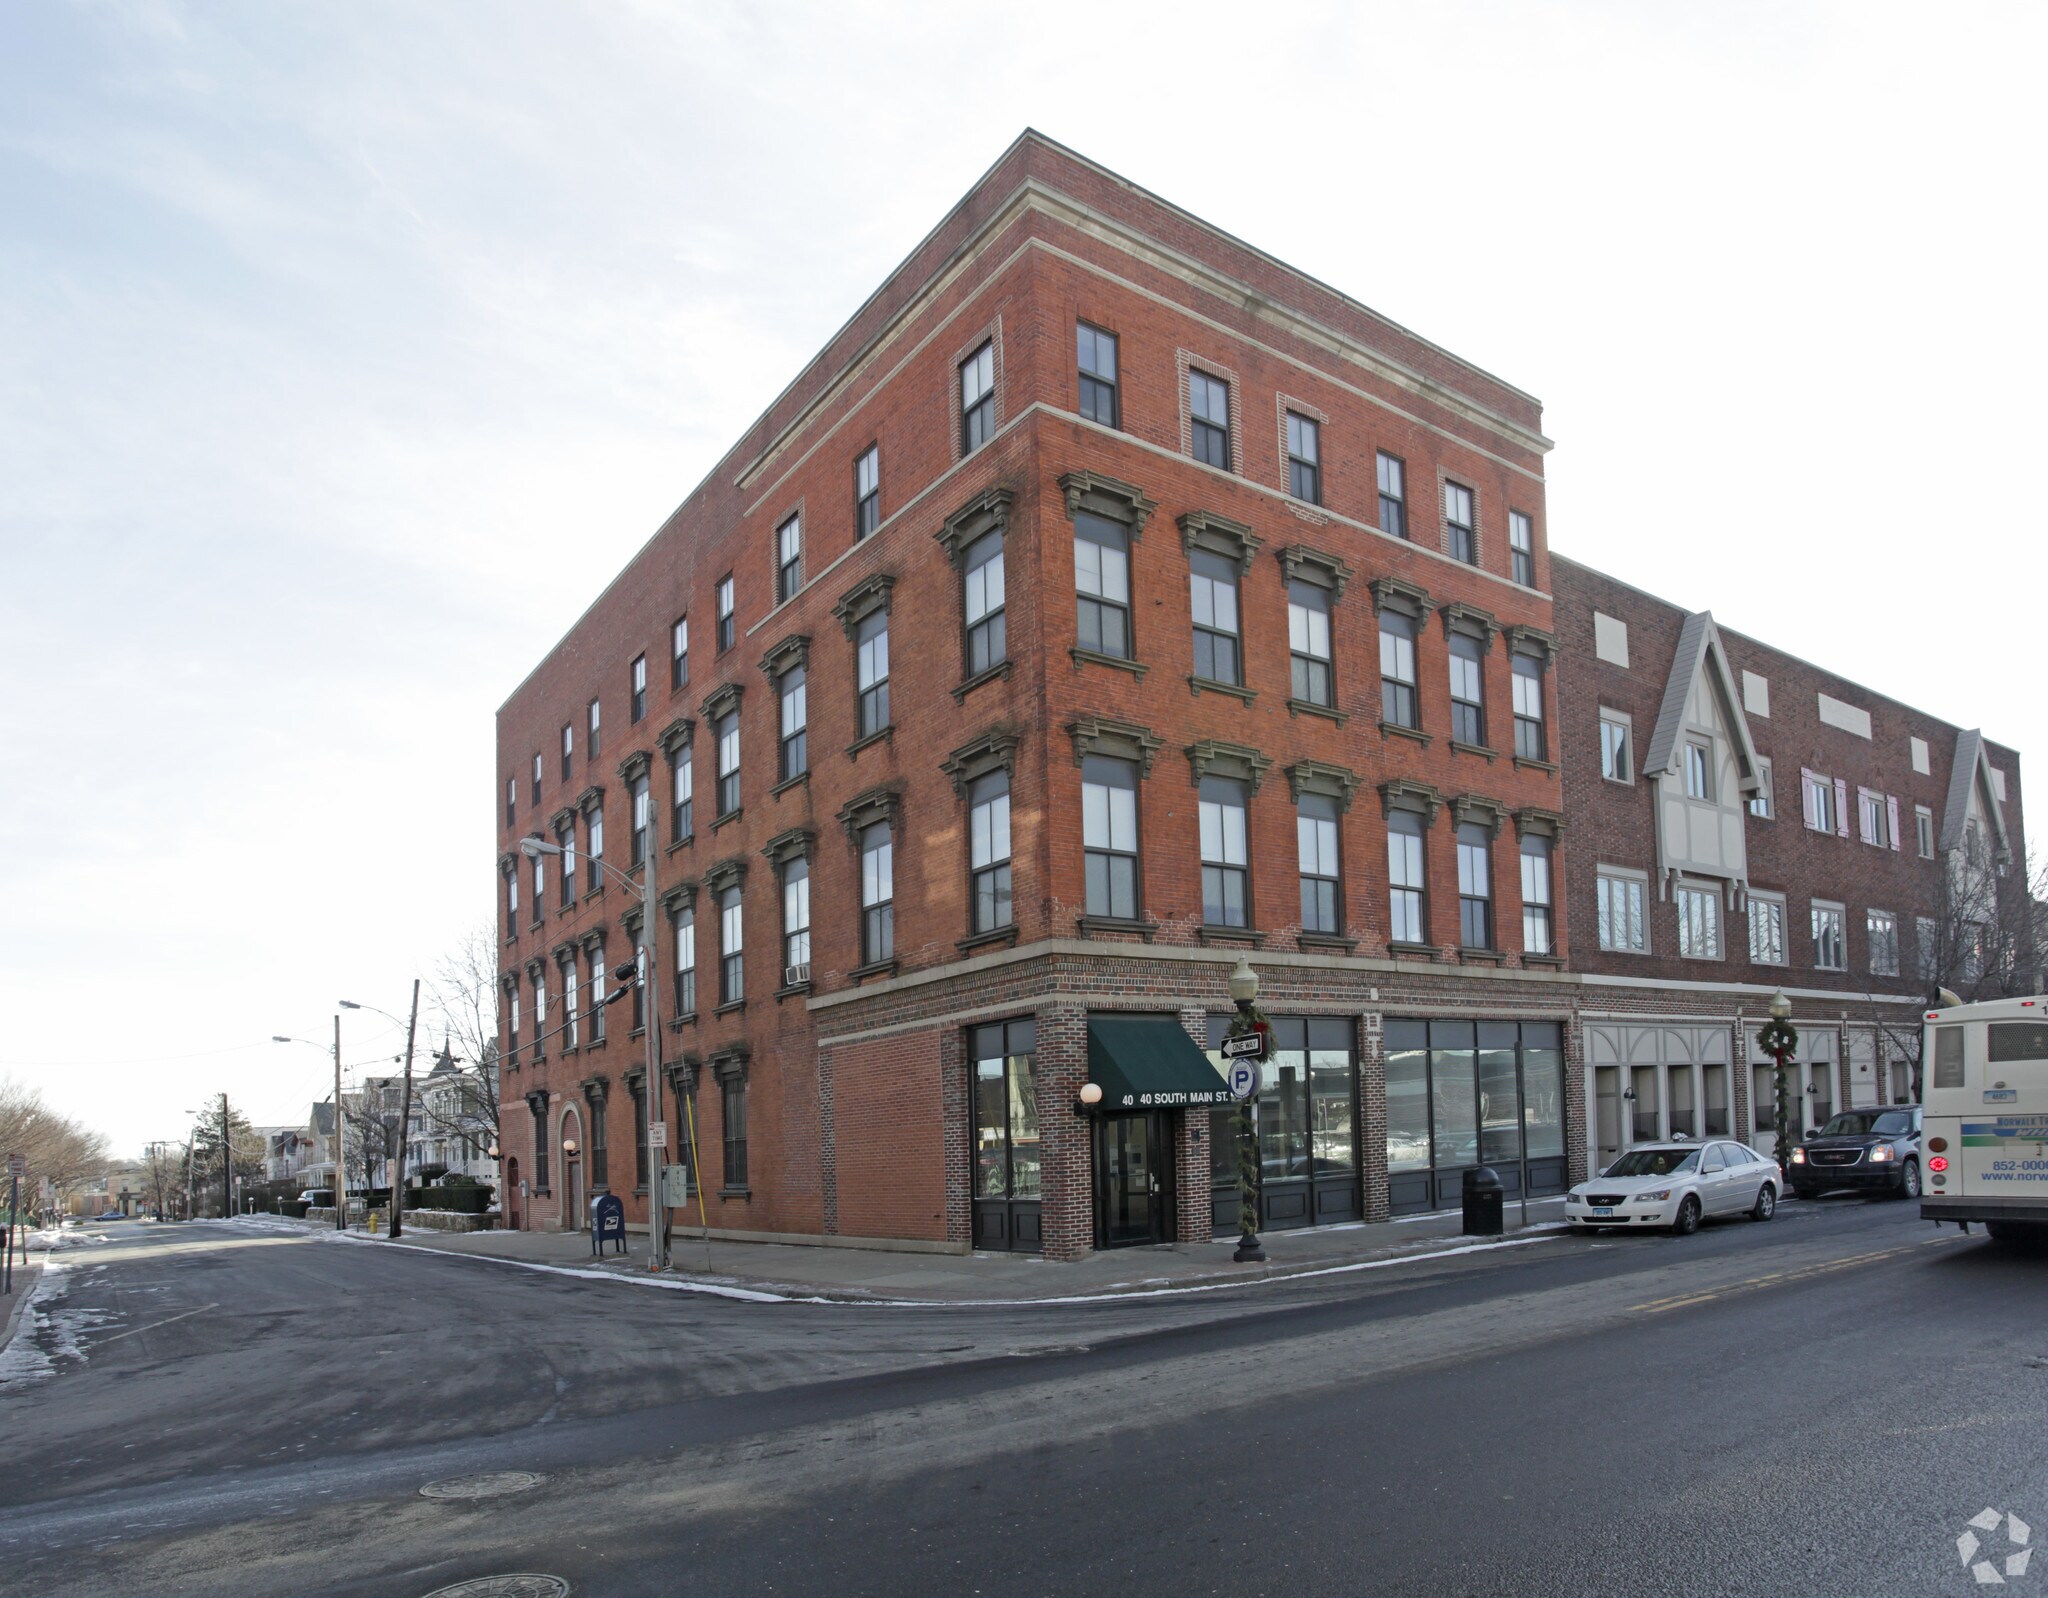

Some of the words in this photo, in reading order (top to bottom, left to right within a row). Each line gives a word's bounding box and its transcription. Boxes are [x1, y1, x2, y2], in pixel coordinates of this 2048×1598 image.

[1232, 1042, 1244, 1051] ONE
[1244, 1040, 1257, 1049] WAY
[1235, 1071, 1249, 1089] P
[1122, 1095, 1133, 1105] 40
[1140, 1094, 1152, 1104] 40
[1154, 1092, 1187, 1104] SOUTH
[1190, 1092, 1213, 1103] MAIN
[1215, 1091, 1228, 1102] ST.
[1997, 1117, 2038, 1127] NORWALK
